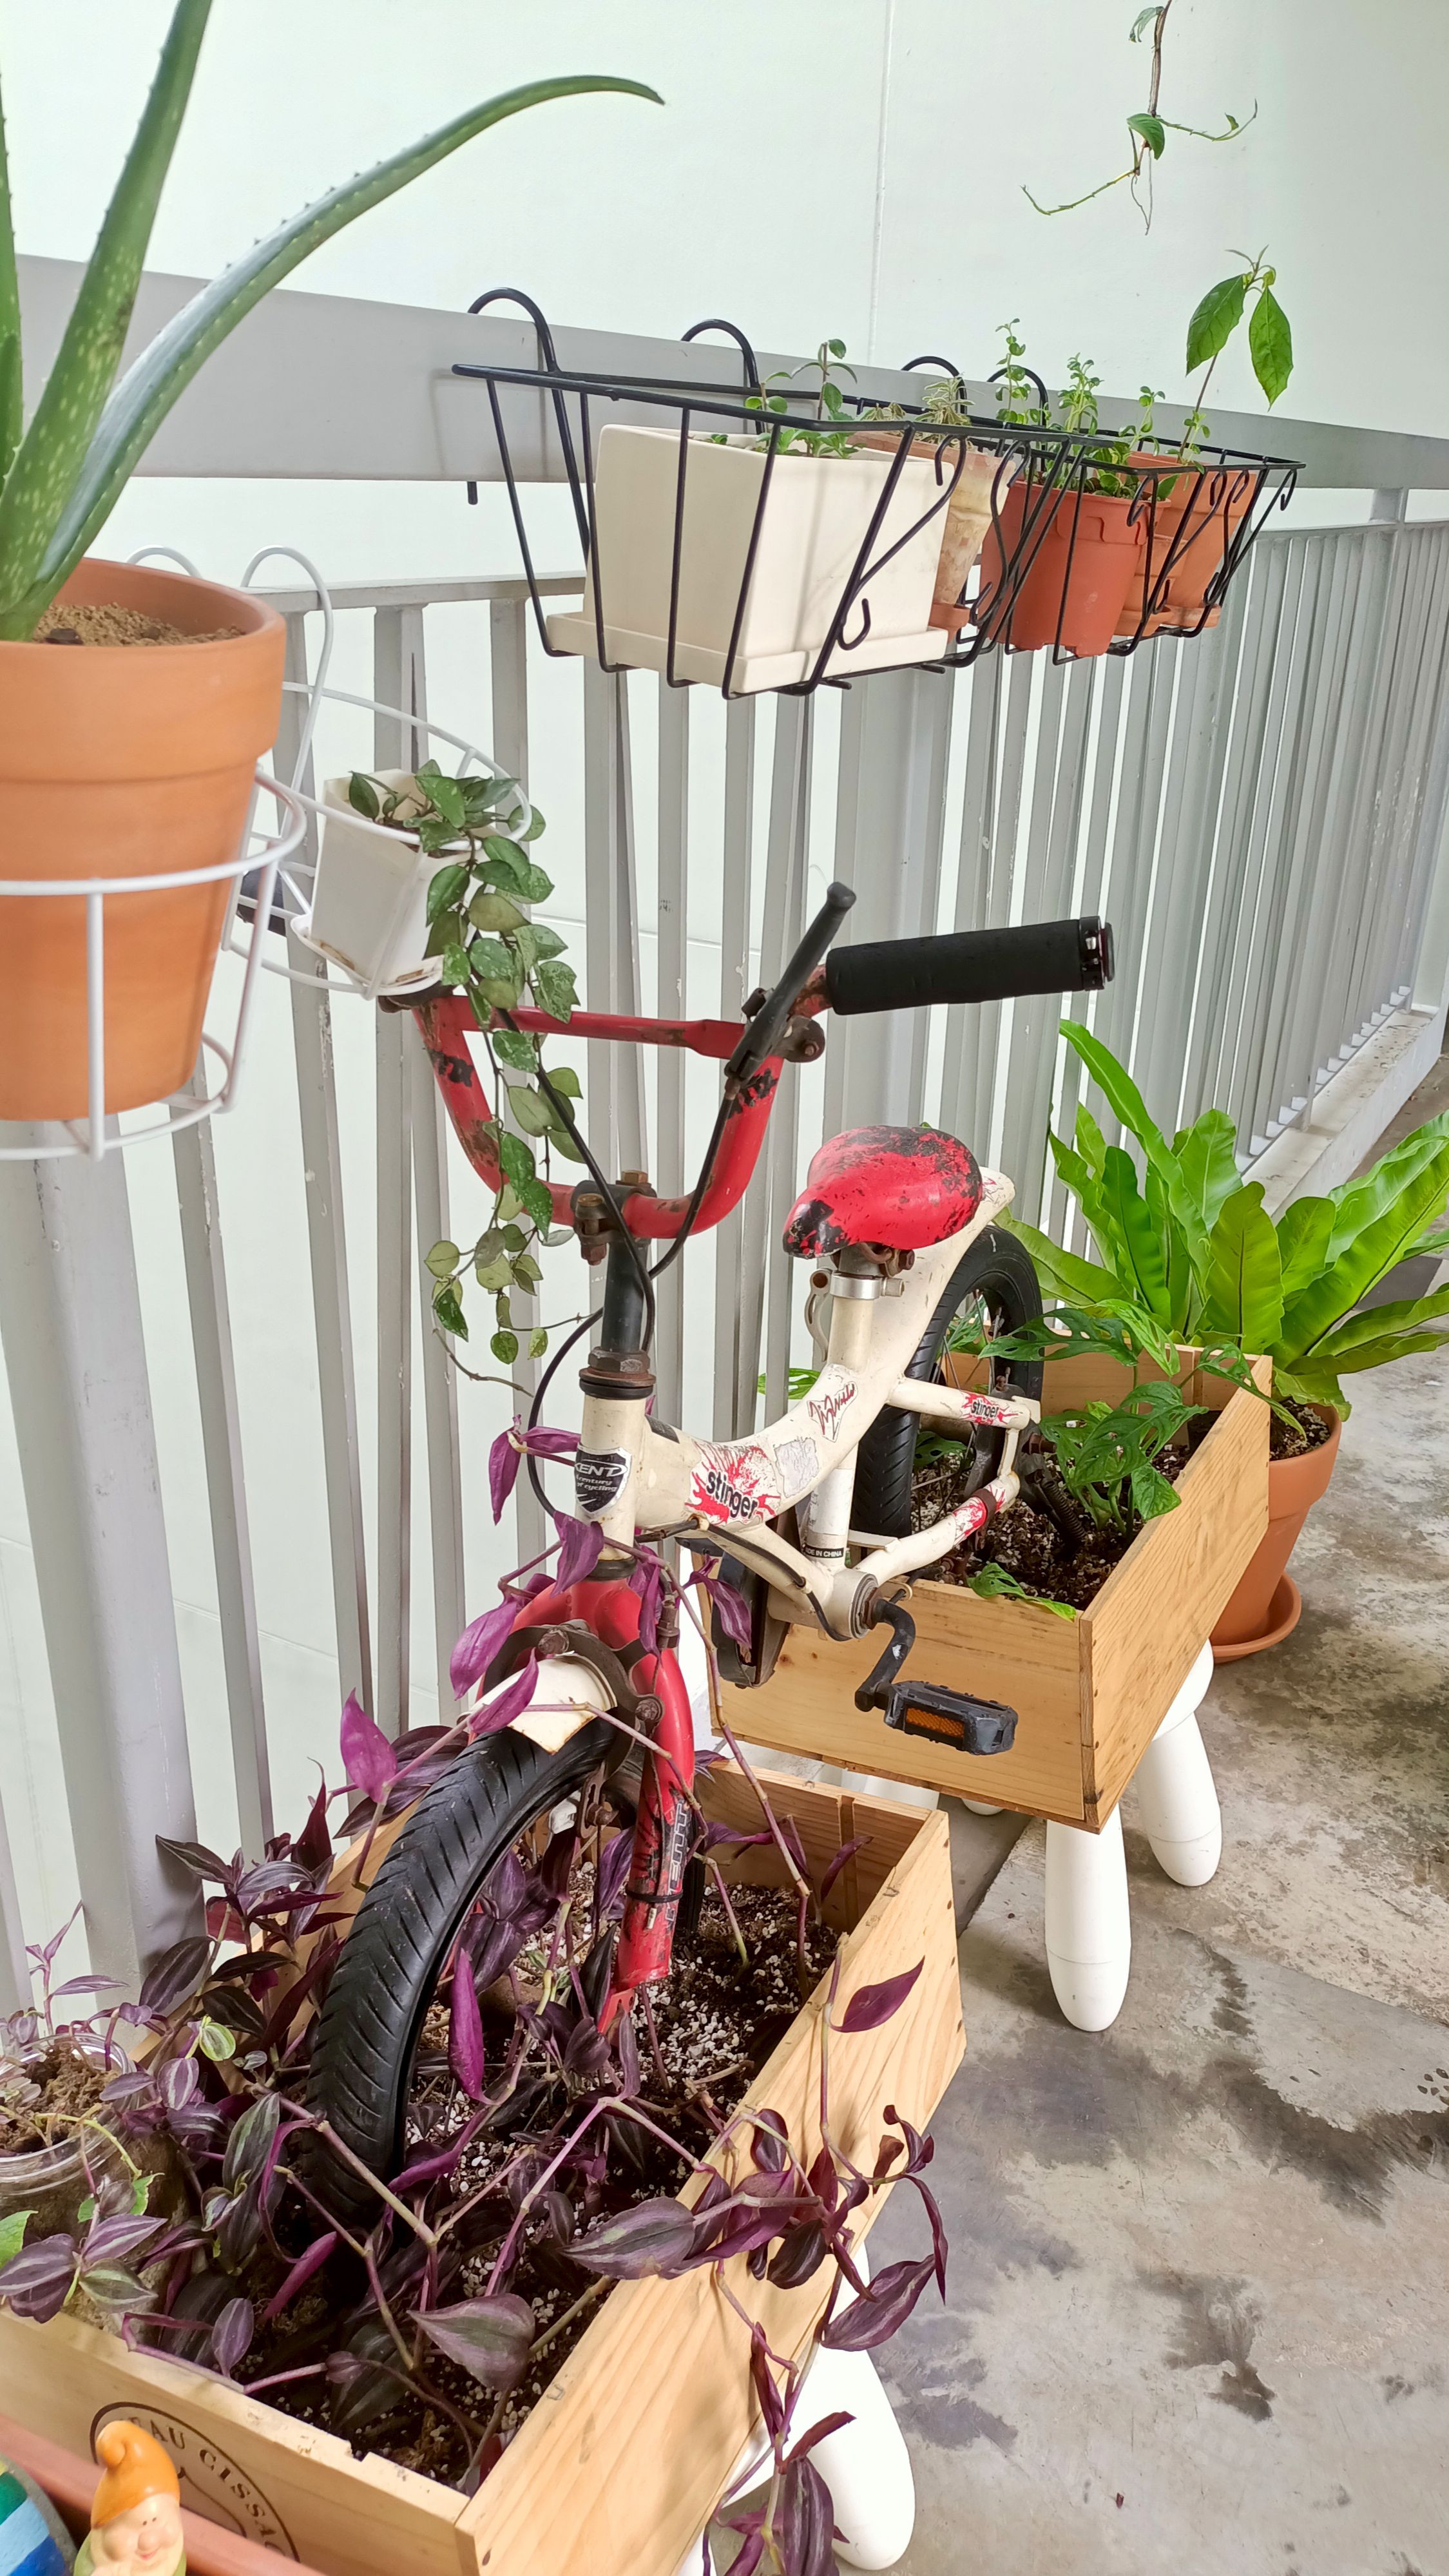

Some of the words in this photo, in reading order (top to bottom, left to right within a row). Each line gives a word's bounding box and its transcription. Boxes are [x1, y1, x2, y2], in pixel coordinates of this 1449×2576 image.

[970, 1399, 999, 1419] stinger
[579, 1475, 613, 1485] century
[706, 1471, 758, 1519] stinger
